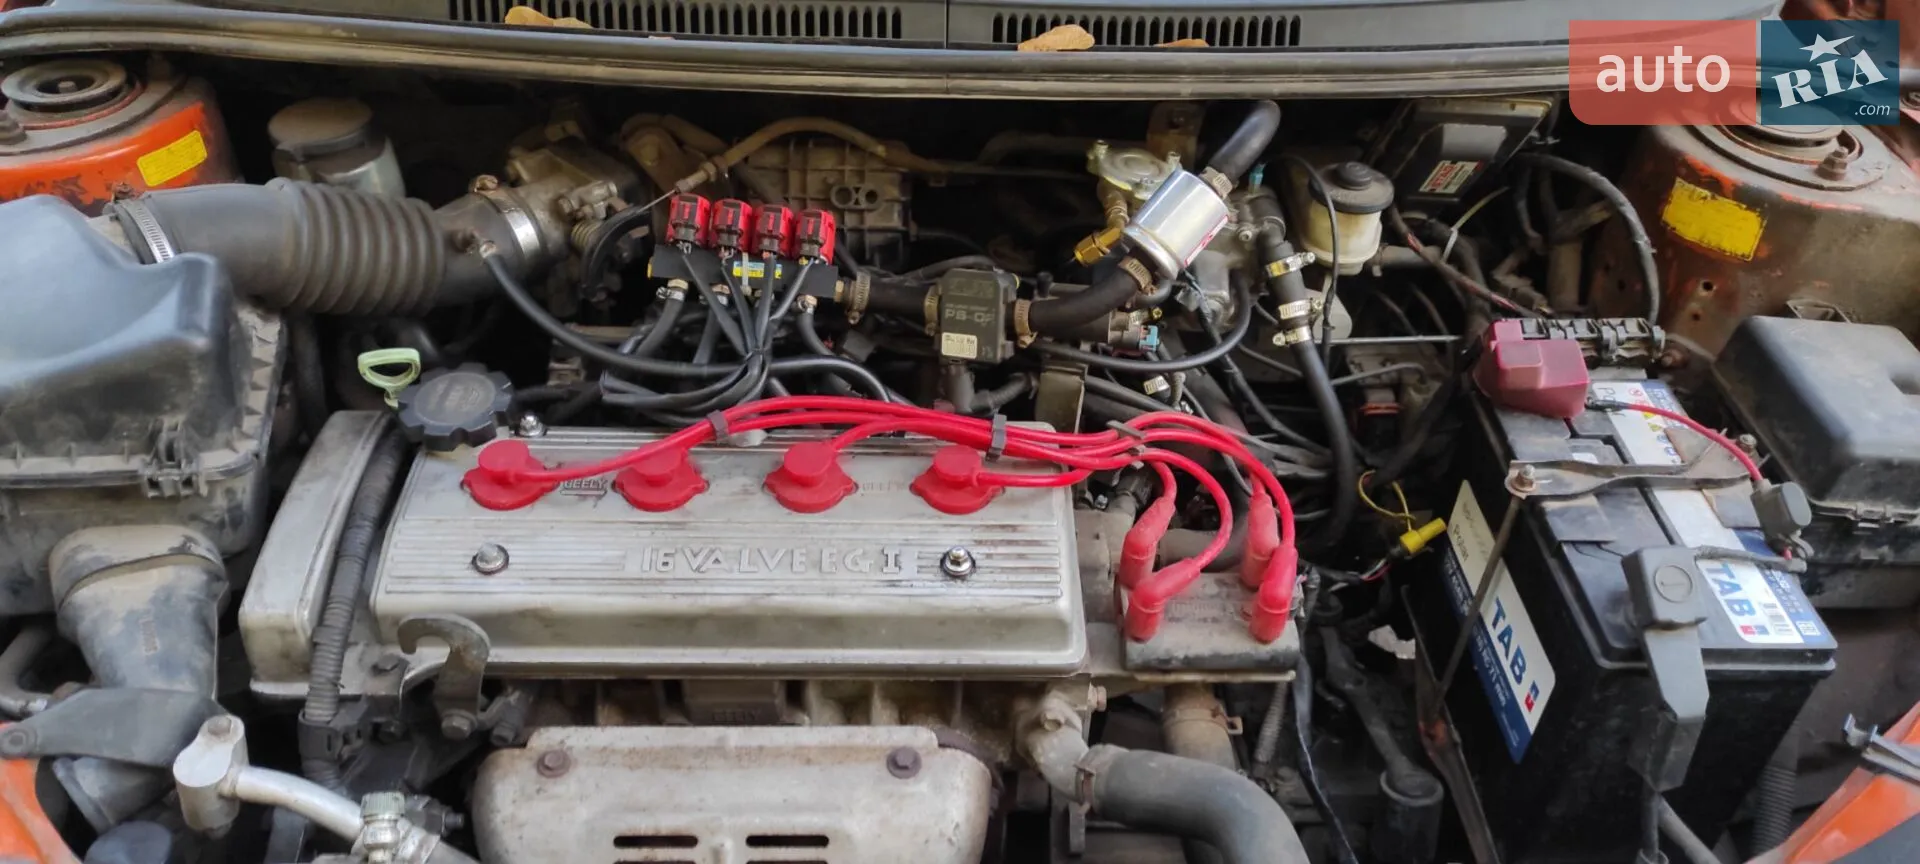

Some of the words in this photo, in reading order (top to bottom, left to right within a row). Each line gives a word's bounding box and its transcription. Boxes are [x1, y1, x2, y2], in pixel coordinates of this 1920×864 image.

[820, 548, 901, 574] EGI
[1705, 560, 1757, 617] TAB
[1492, 597, 1527, 686] TAB
